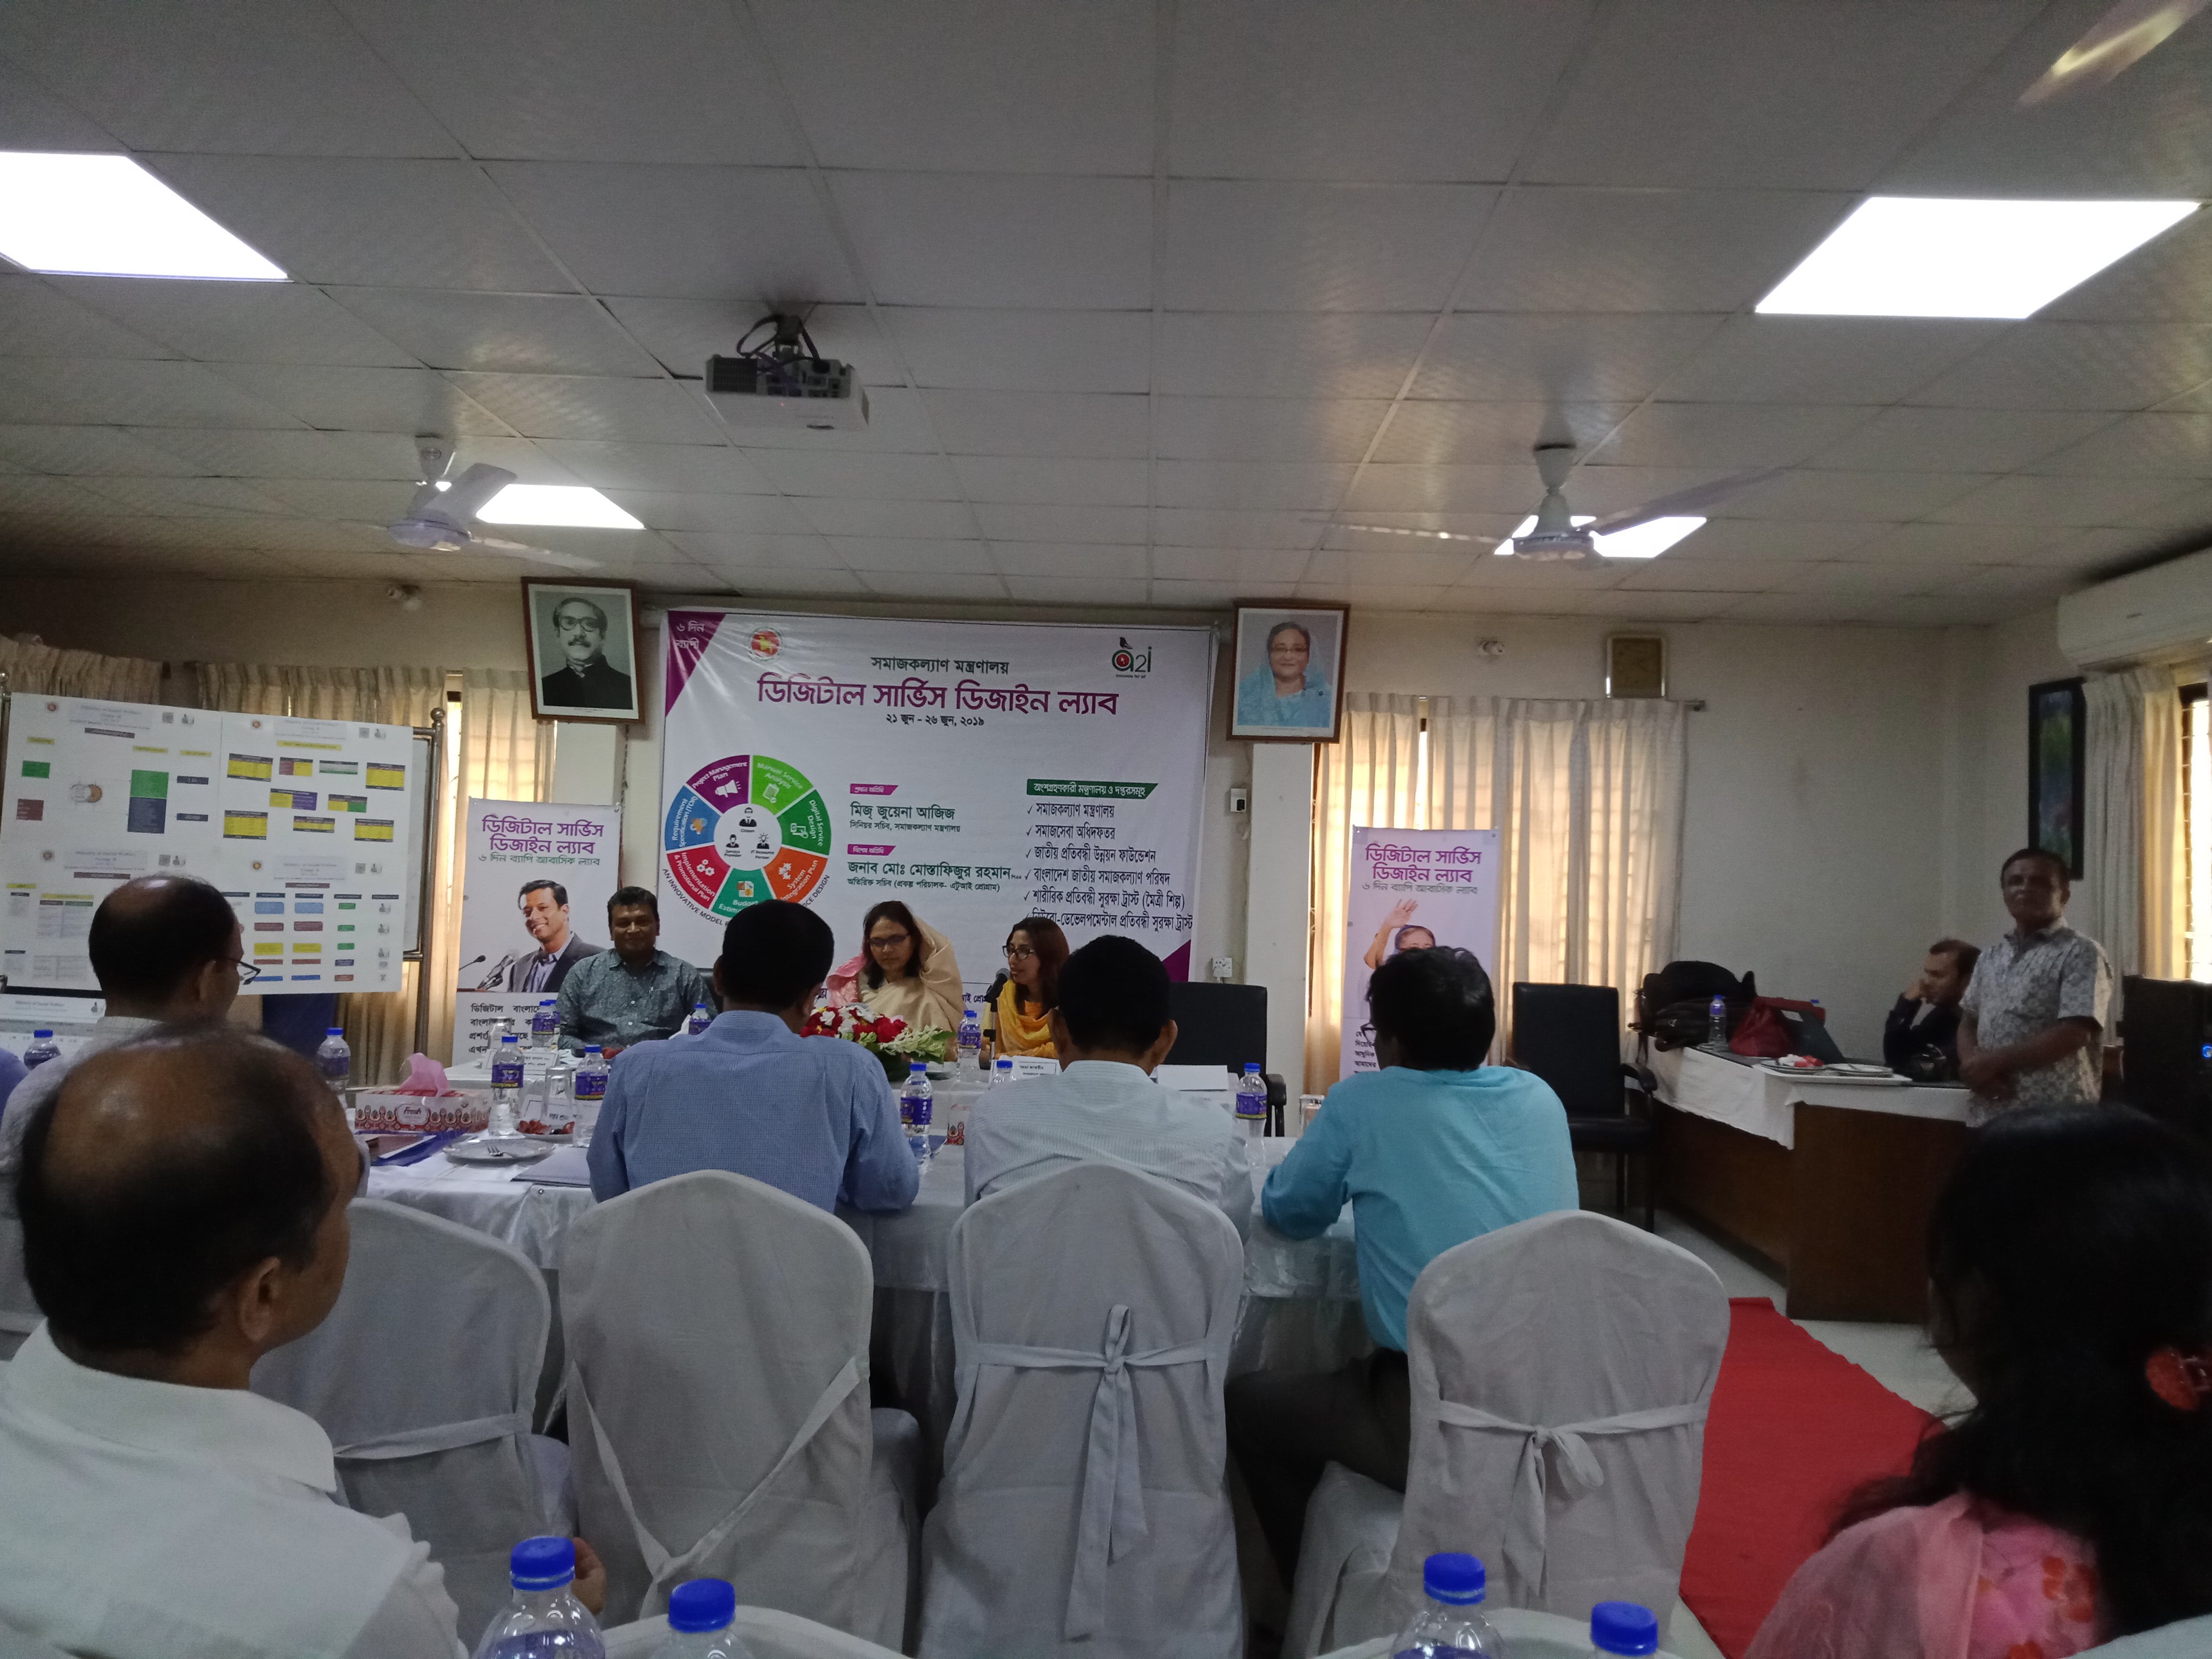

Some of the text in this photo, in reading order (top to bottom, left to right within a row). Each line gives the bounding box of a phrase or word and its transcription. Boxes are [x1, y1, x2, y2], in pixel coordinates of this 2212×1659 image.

[676, 621, 705, 633] ৬ দিন
[871, 657, 1009, 675] সমাজকল্যাণ মন্ত্রণালয়
[757, 672, 1119, 715] ডিজিটাল সার্ভিস ডিজাইন ল্যাব
[886, 714, 898, 723] ২১
[901, 714, 915, 725] জুন
[926, 715, 937, 725] ২৬
[940, 716, 957, 726] জুন,
[960, 716, 984, 726] ২০১৯
[692, 761, 747, 789] Project Management
[713, 772, 728, 781] Plan
[765, 773, 792, 789] Analysis
[783, 772, 803, 789] Service
[1034, 782, 1077, 793] অংশগ্রহণকারী
[1078, 784, 1106, 795] মন্ত্রণালয়
[1115, 785, 1146, 798] দপ্তরসমূহ
[672, 799, 688, 841] Requirement
[809, 800, 823, 821] Digital
[877, 805, 912, 820] জুয়েনা
[916, 804, 956, 820] আজিজ
[1036, 802, 1115, 818] সমাজকল্যাণ মন্ত্রণালয়
[482, 814, 604, 837] ডিজিটাল সার্ভিস
[808, 815, 816, 839] Design
[850, 820, 872, 830] সিনিয়র
[894, 823, 932, 832] সমাজকল্যাণ
[934, 824, 961, 833] মন্ত্রণালয়
[1036, 822, 1116, 840] সমাজসেবা অধিদফতর
[490, 833, 595, 854] ডিজাইন ল্যাব
[1034, 842, 1156, 864] জাতীয় প্রতিবন্ধী উন্নয়ন ফাউন্ডেশন
[1365, 843, 1482, 865] ডিজিটাল সার্ভিস
[490, 851, 507, 862] দিন
[510, 853, 533, 864] ব্যাপি
[536, 854, 575, 865] আবাসিক
[579, 858, 600, 866] ল্যাব
[808, 859, 818, 875] Plan
[676, 859, 699, 892] Promotional
[698, 889, 710, 901] Plan
[681, 852, 716, 896] Implementation
[787, 869, 806, 890] System
[848, 861, 878, 875] জনাব
[883, 862, 905, 876] মোঃ
[910, 861, 971, 881] মোস্তাফিজুর
[975, 866, 1011, 879] রহমান
[1034, 865, 1171, 886] বাংলাদেশ জাতীয় সমাজকল্যাণ পরিষদ
[1372, 861, 1473, 883] ডিজাইন ল্যাব
[812, 875, 830, 898] DESIGN
[876, 877, 892, 887] সচিব
[1373, 880, 1388, 891] দিন
[1391, 882, 1413, 892] ব্যাপি
[1415, 883, 1453, 893] আবাসিক
[1456, 886, 1478, 894] ল্যাব
[663, 868, 723, 926] AN INNOVATIVE MODEL
[1032, 885, 1063, 903] শারীরিক
[1065, 886, 1095, 905] প্রতিবন্ধী
[1099, 891, 1120, 909] সুরক্ষা
[1122, 889, 1139, 908] ট্রাস্ট
[1119, 910, 1150, 929] প্রতিবন্ধী
[1152, 915, 1174, 933] সুরক্ষা
[1176, 914, 1193, 932] ট্রাস্ট
[471, 1003, 504, 1012] ডিজিটাল
